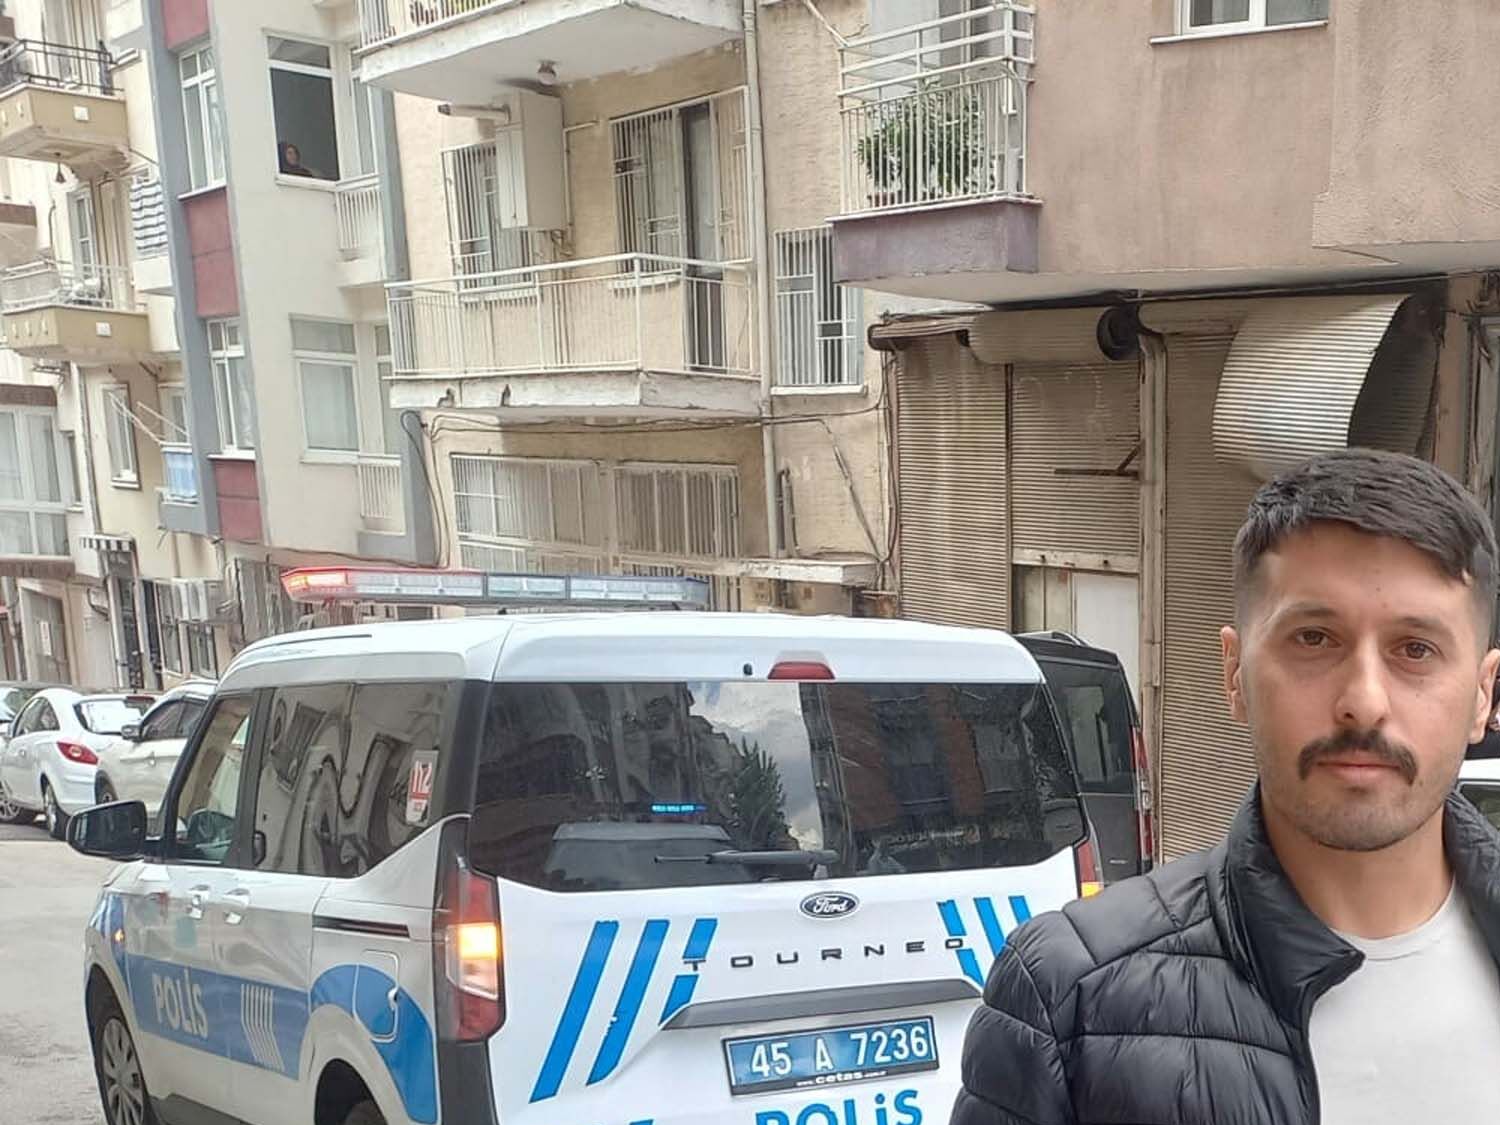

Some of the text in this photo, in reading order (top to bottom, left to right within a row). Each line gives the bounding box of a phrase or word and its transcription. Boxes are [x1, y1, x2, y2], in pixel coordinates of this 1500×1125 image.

[683, 937, 964, 971] TOURNEO
[751, 1025, 928, 1078] 45 A 7236
